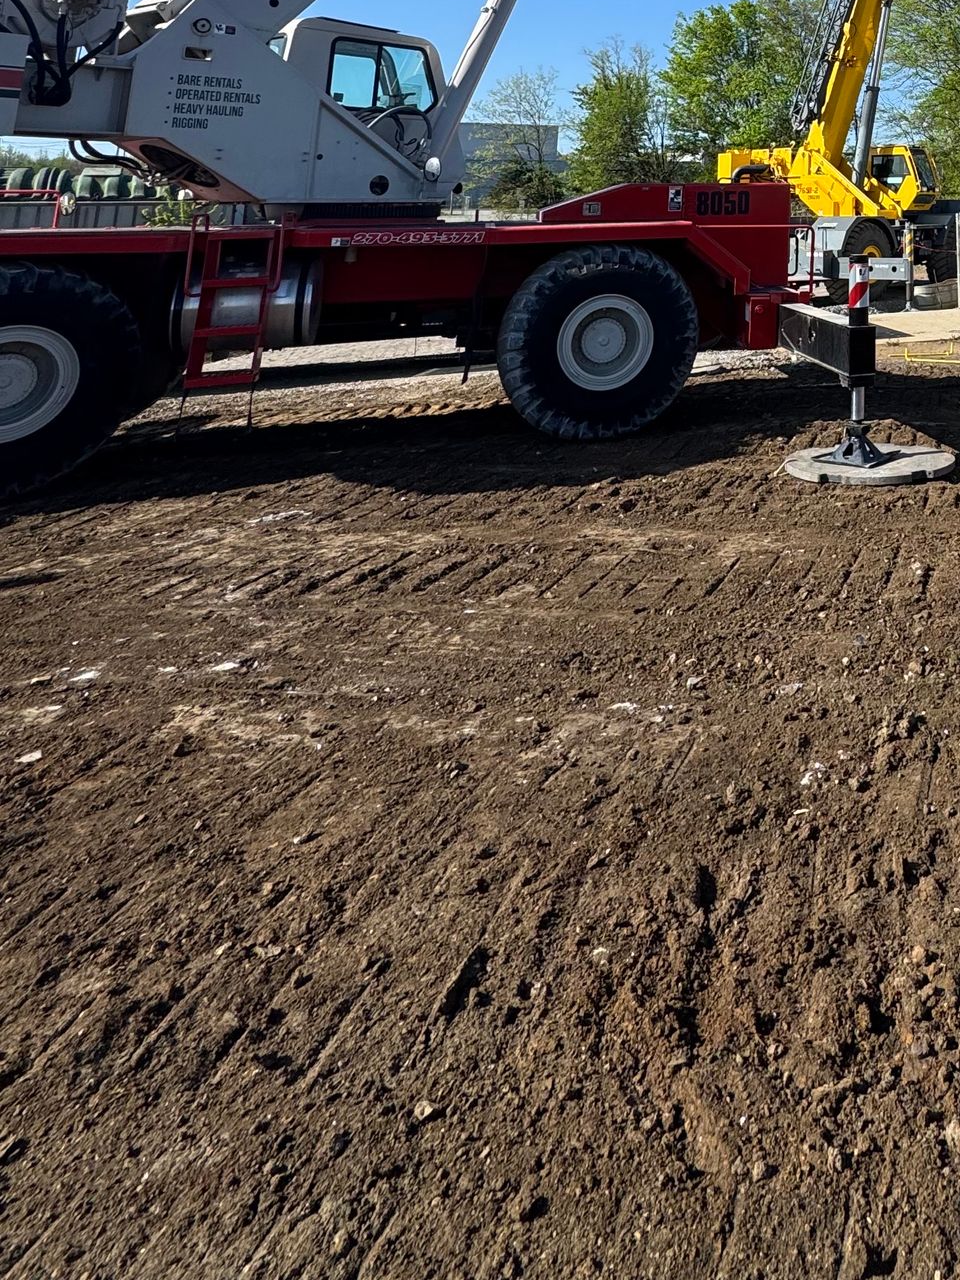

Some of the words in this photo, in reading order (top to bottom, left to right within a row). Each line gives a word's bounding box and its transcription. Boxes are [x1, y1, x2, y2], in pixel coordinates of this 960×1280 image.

[177, 74, 202, 86] BARE
[204, 76, 243, 89] RENTALS
[175, 88, 222, 102] OPERATED
[223, 91, 261, 104] RENTALS
[173, 103, 204, 115] HEAVY
[206, 105, 244, 117] HAULING
[171, 117, 209, 129] RIGGING
[696, 191, 750, 216] 8050
[351, 231, 485, 245] 270-493-3771
